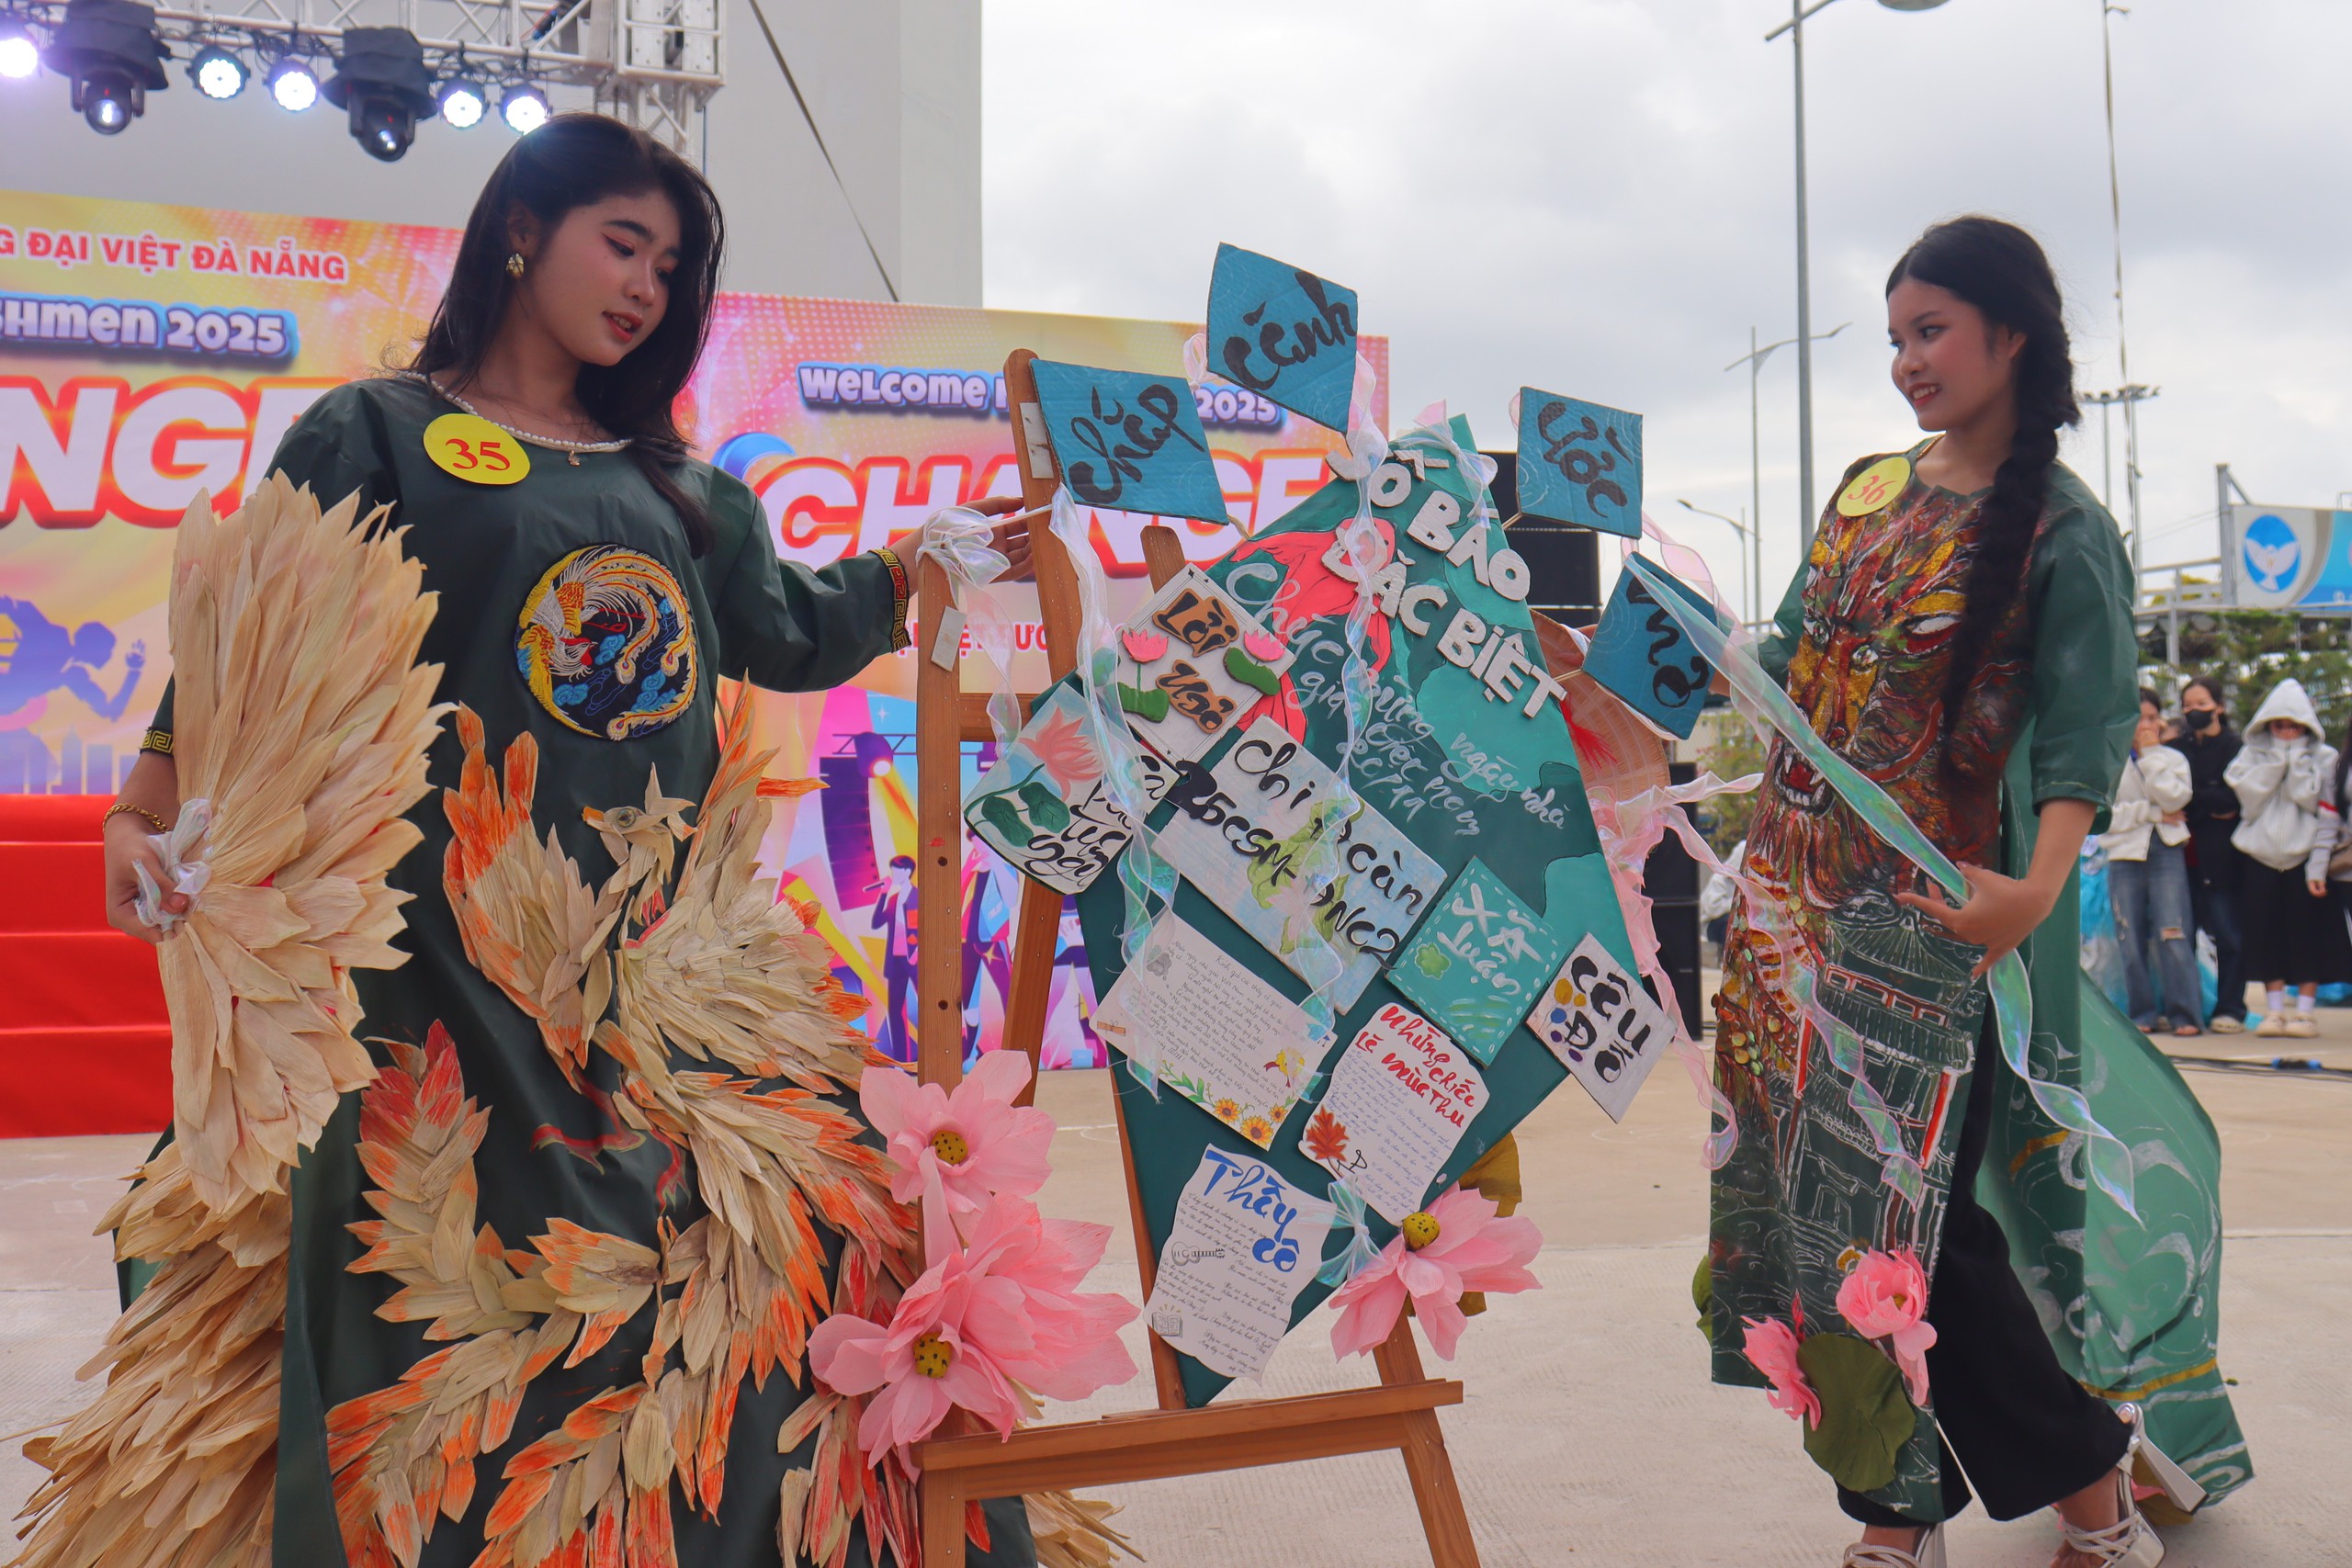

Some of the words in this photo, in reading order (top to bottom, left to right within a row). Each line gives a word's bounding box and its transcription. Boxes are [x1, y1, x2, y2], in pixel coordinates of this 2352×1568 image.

[28, 231, 87, 265] ĐẠI
[102, 234, 181, 273] VIỆT
[192, 237, 238, 273] ĐÀ
[250, 238, 345, 279] NẴNG
[166, 307, 287, 355] 2025
[1194, 387, 1277, 423] 2025
[445, 438, 511, 471] 35
[1847, 475, 1897, 505] 36
[1204, 1150, 1298, 1243] Thầy
